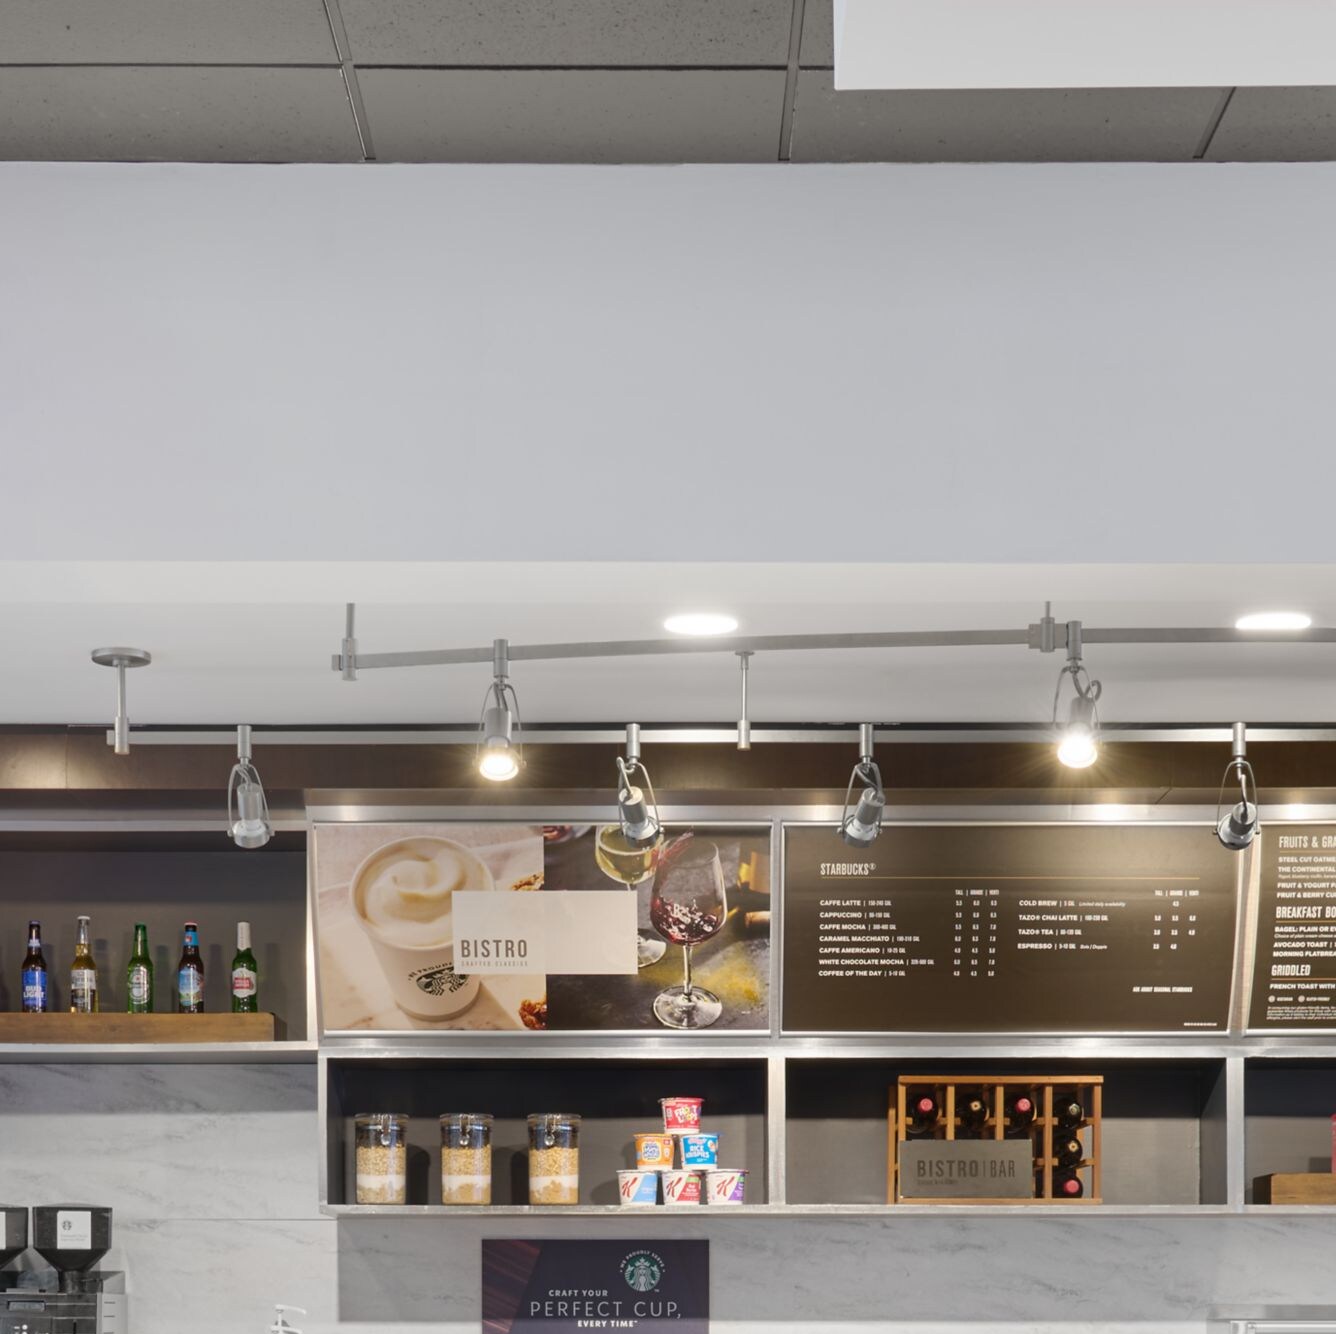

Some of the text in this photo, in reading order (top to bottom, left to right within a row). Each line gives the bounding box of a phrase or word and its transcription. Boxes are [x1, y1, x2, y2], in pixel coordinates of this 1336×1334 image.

[1279, 836, 1308, 848] FRUITS
[1311, 836, 1319, 848] &
[1276, 906, 1322, 918] BREAKFAST
[460, 939, 528, 958] BISTRO
[1271, 964, 1311, 976] GRIDDLED
[917, 1159, 1015, 1178] BISTRO BAR
[549, 1289, 608, 1297] CRAFT YOUR
[530, 1301, 681, 1319] PERFECT CUP,
[577, 1320, 606, 1328] EVERY
